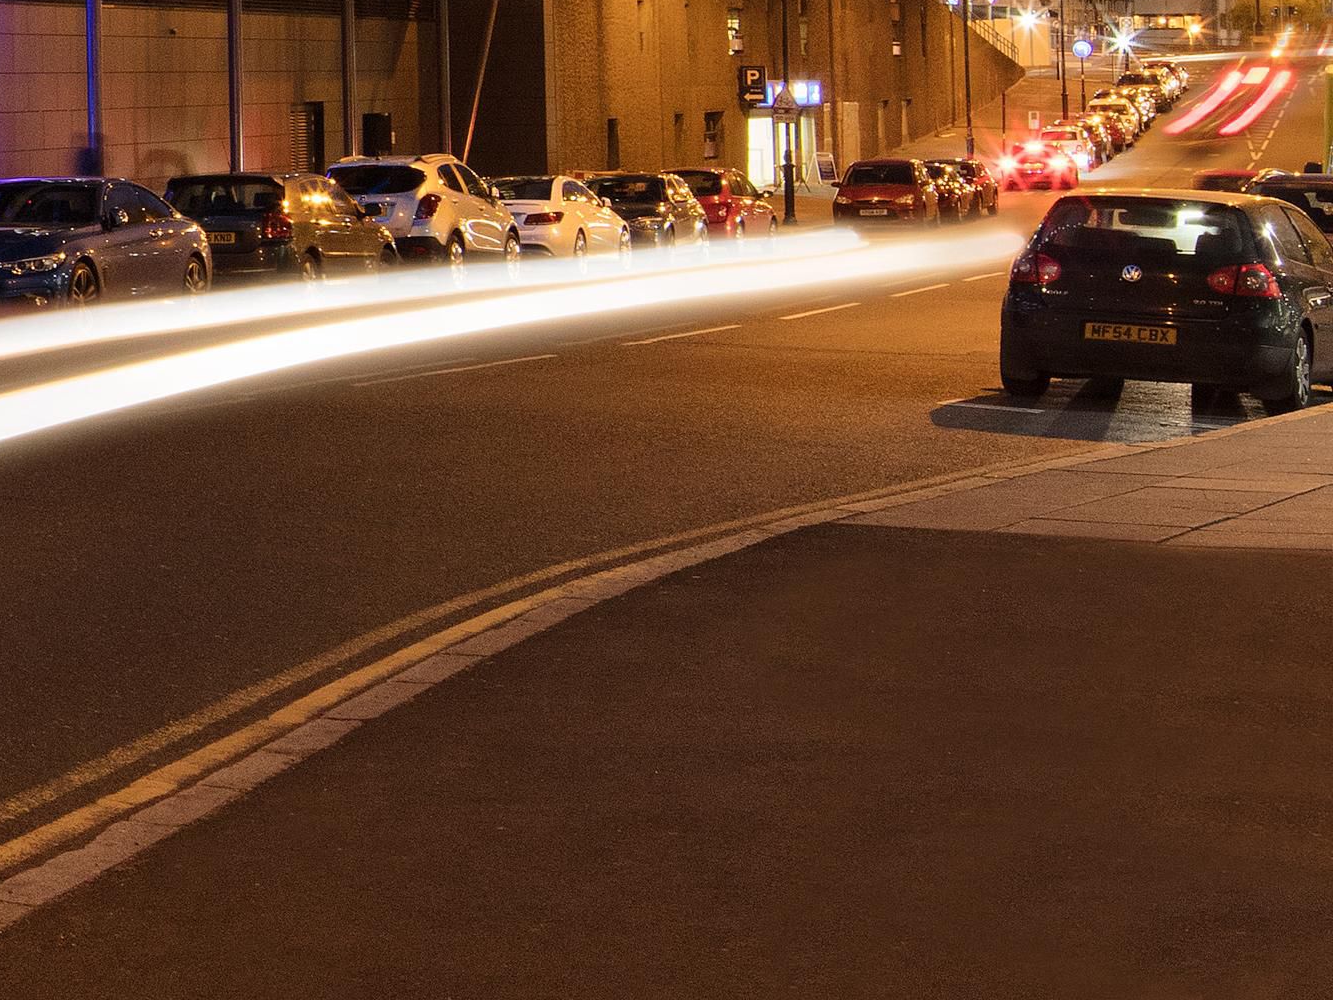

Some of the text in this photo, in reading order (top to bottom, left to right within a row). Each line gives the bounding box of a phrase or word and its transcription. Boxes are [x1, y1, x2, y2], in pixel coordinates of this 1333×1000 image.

[747, 70, 759, 85] P
[1091, 325, 1170, 341] MF54 CBX
